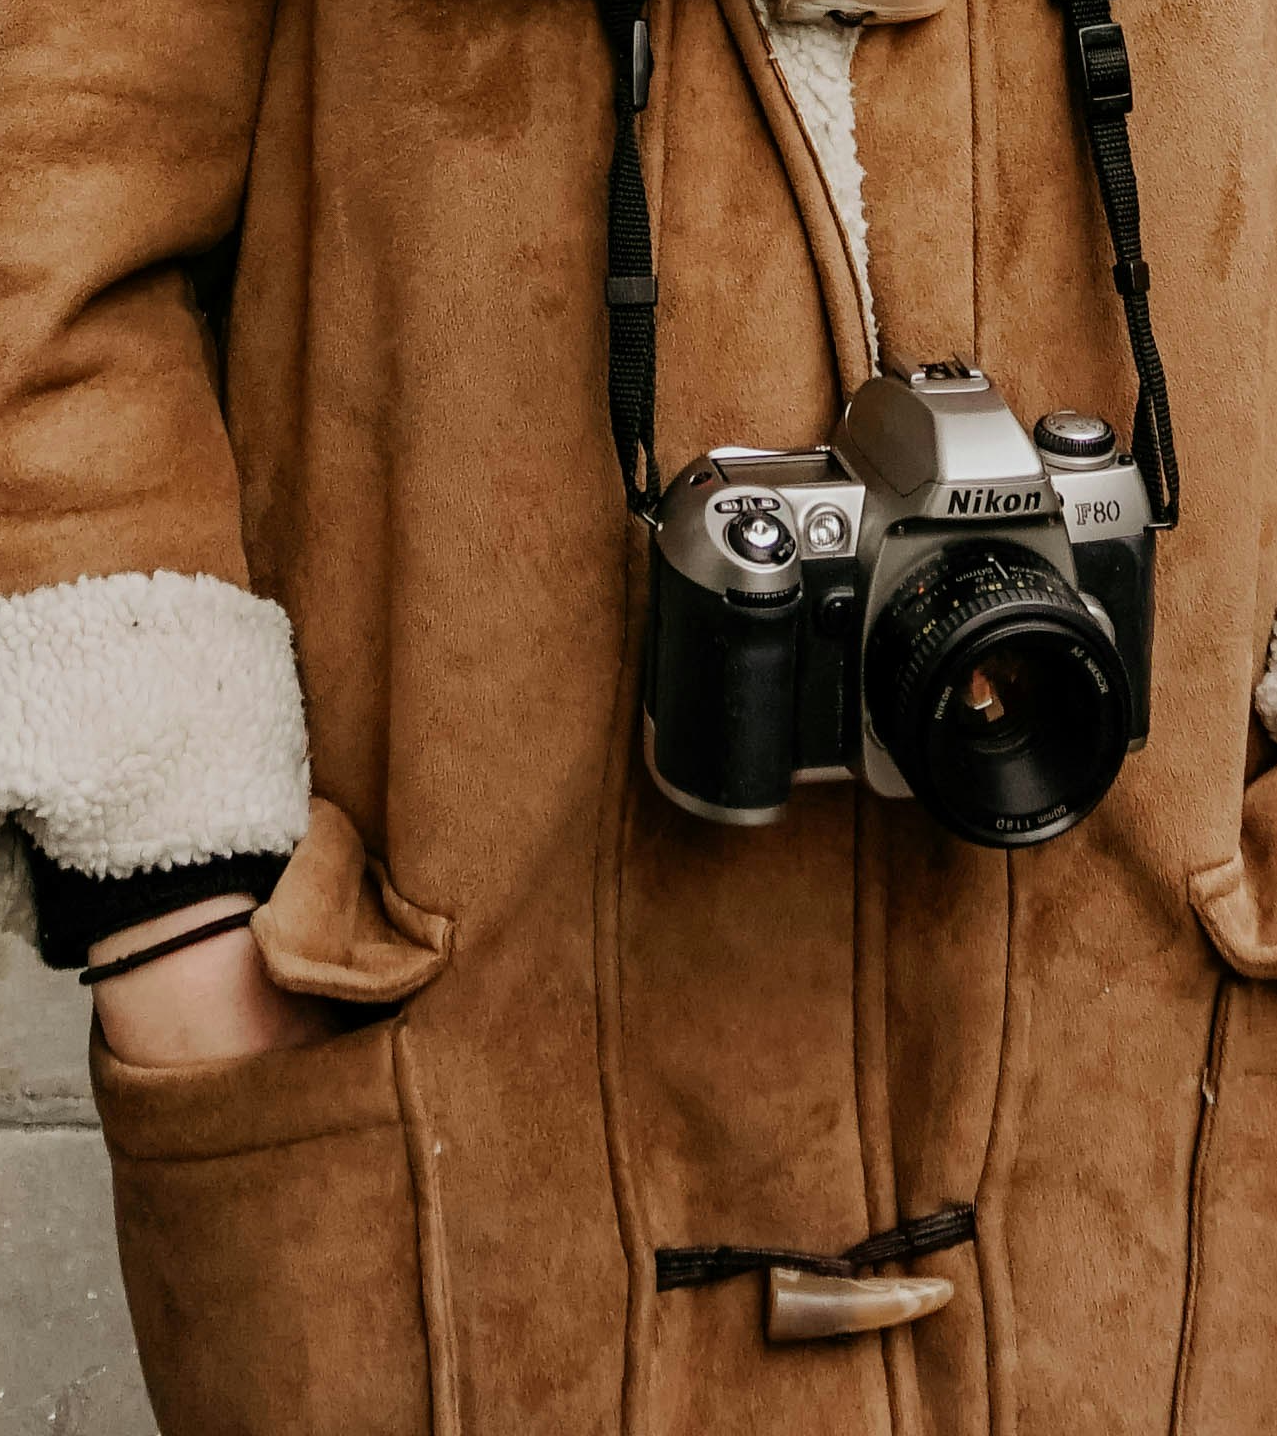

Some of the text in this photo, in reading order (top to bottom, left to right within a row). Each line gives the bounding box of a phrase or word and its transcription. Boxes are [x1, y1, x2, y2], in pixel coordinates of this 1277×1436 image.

[947, 488, 1043, 515] Nikon
[1075, 499, 1121, 526] F80
[933, 685, 954, 720] Nikon
